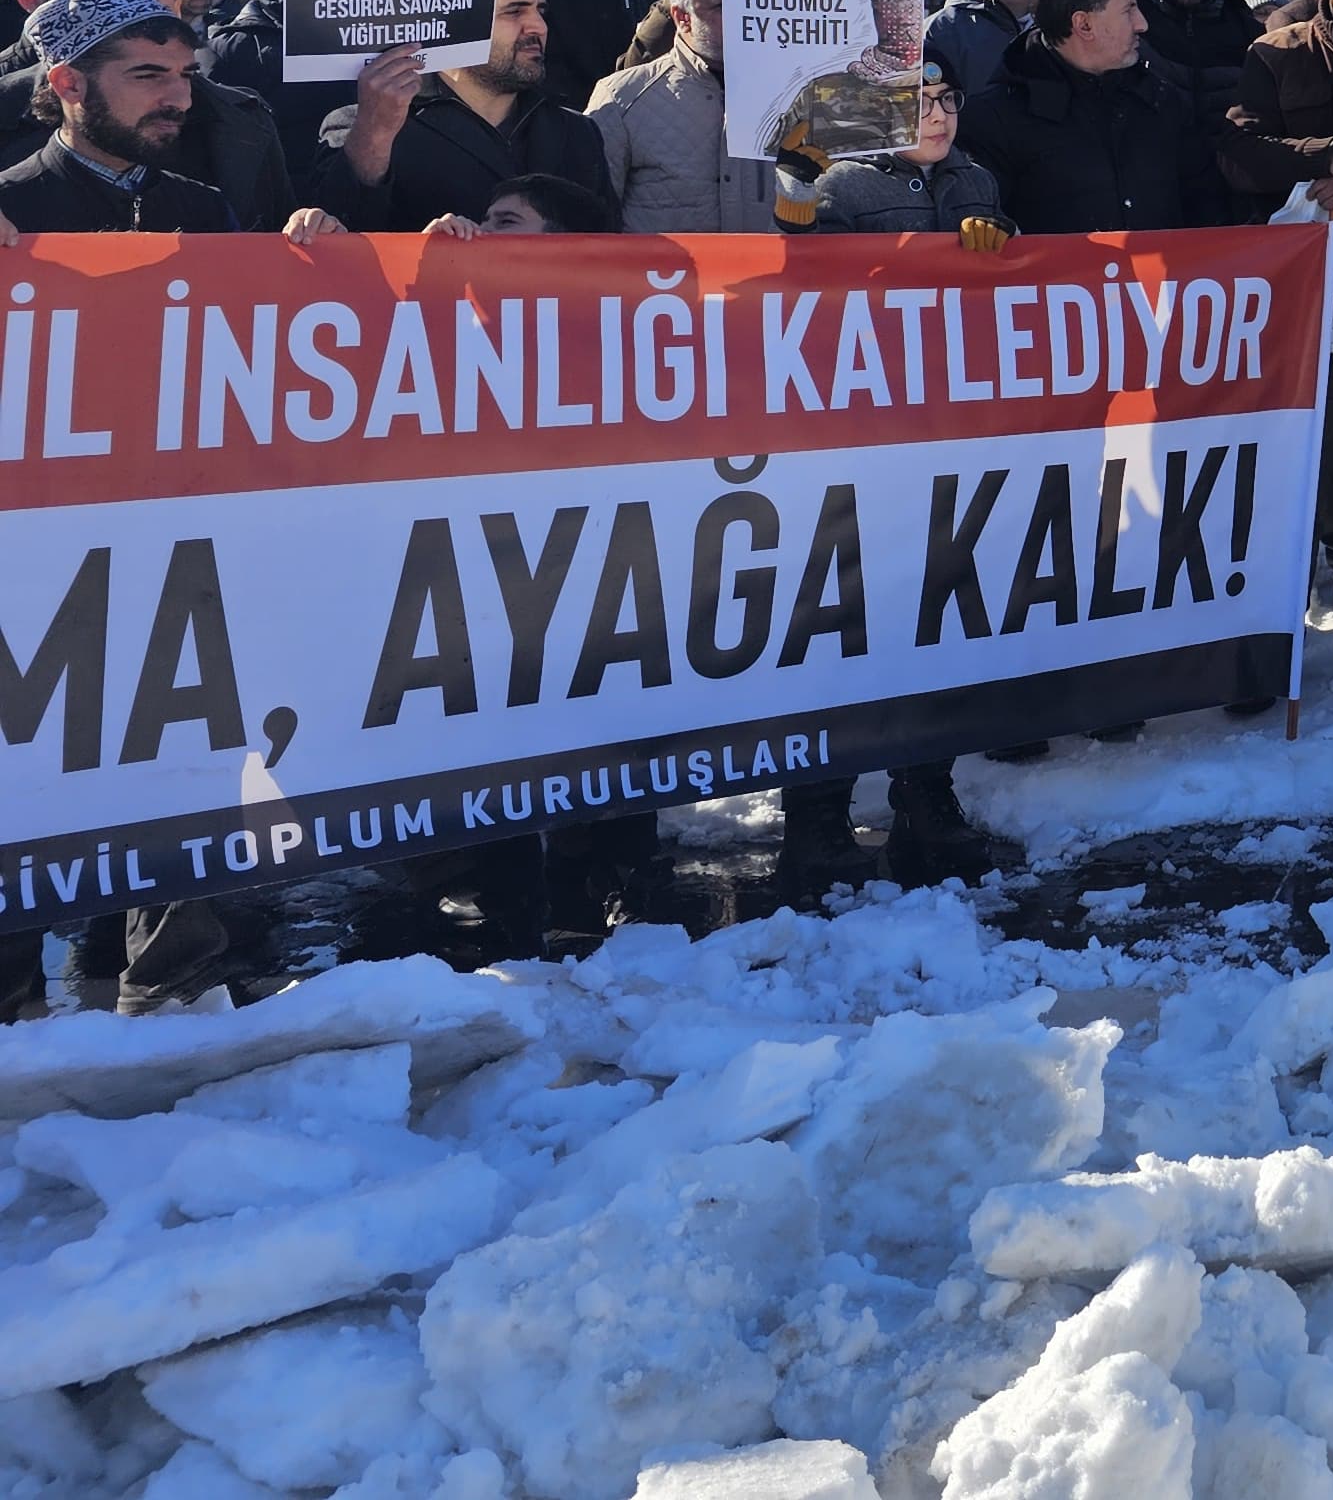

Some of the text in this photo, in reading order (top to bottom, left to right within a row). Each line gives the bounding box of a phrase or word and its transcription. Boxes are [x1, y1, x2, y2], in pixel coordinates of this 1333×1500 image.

[338, 17, 450, 46] YİĞİTLERİDİR.
[742, 14, 848, 49] EY ŞEHİT!
[156, 270, 727, 451] İNSANLIĞI
[762, 261, 1273, 414] KATLEDİYOR
[0, 442, 1259, 774] MA, AYAĞA KALK!
[181, 799, 435, 879] TOPLUM
[462, 729, 830, 829] KURULUŞLARI
